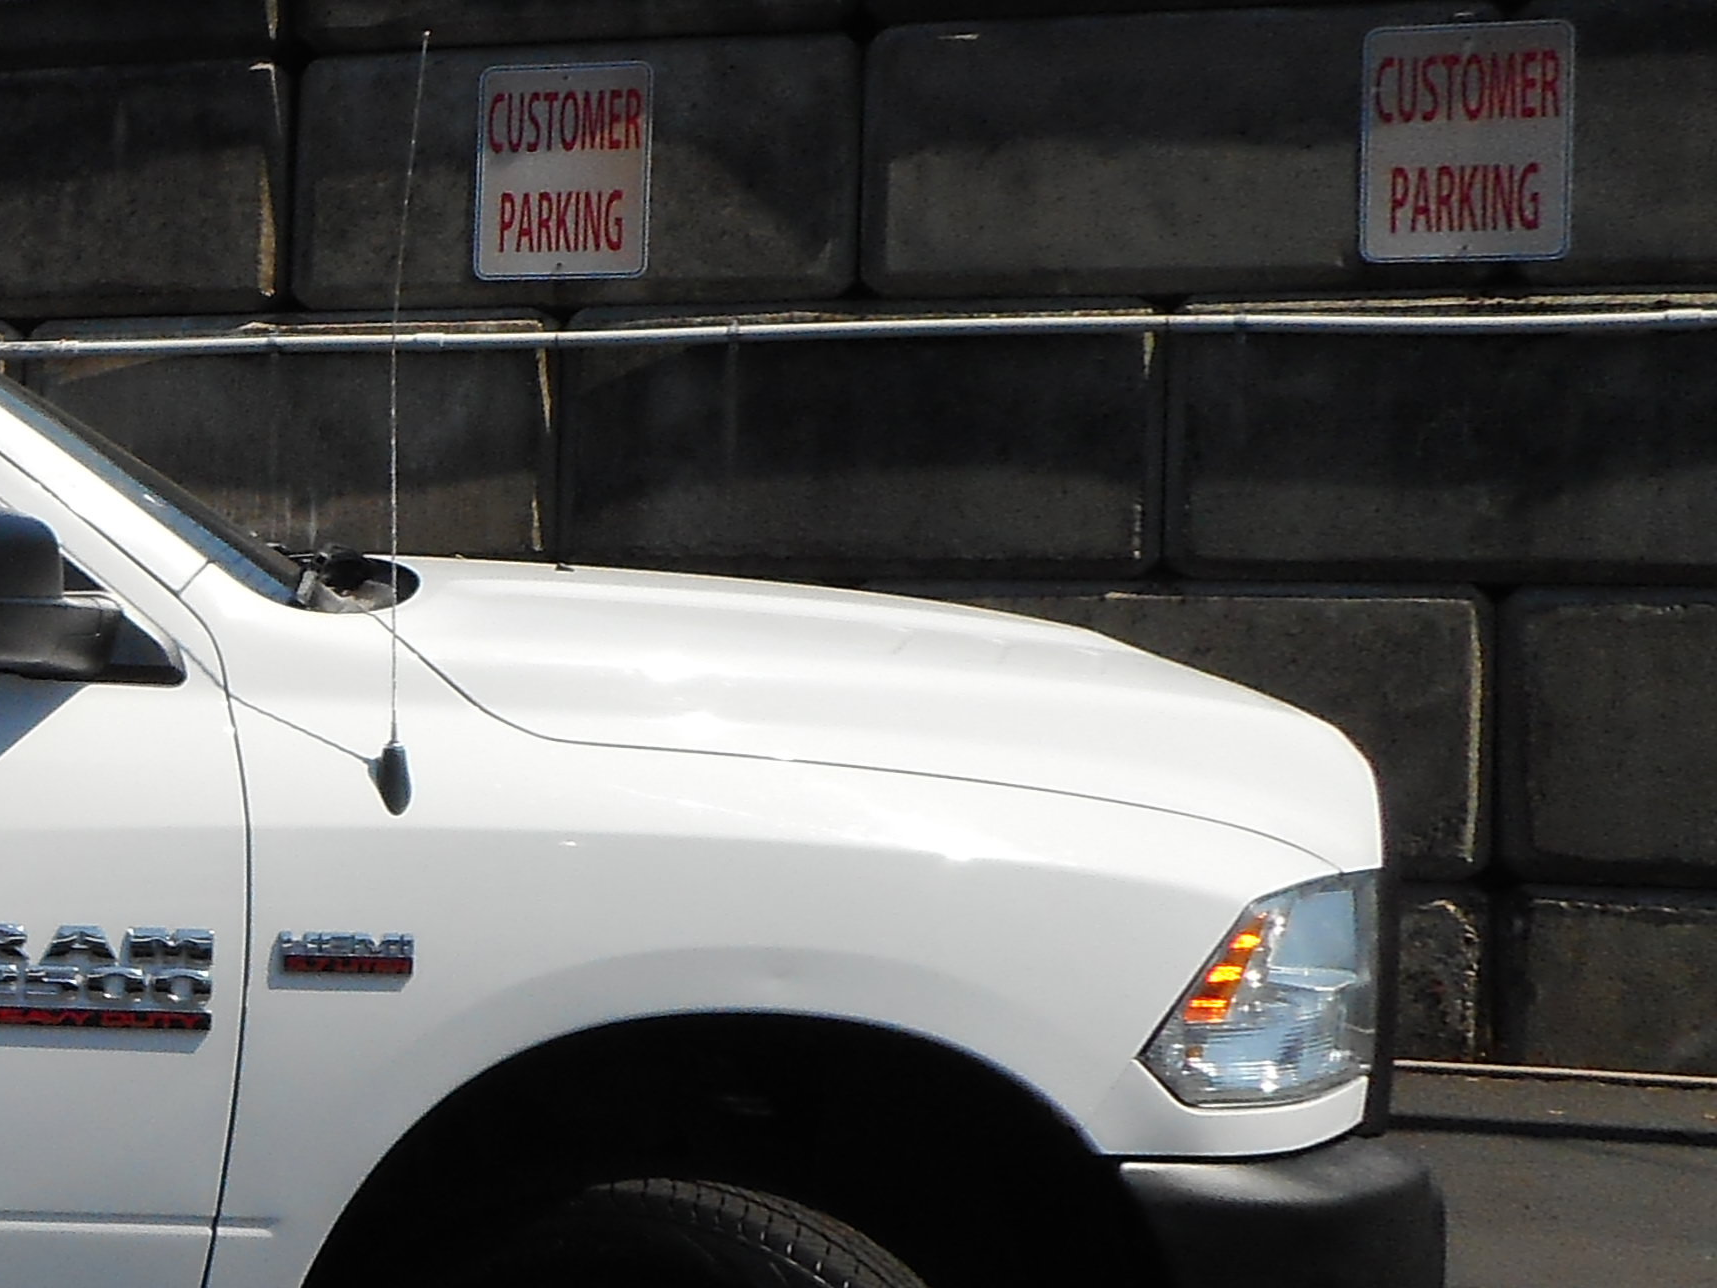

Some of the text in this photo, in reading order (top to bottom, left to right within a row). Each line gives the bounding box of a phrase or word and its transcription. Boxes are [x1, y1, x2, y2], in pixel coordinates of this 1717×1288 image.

[1374, 48, 1561, 124] CUSTOMER
[487, 88, 643, 154] CUSTOMER
[497, 189, 624, 253] PARKING
[1389, 161, 1541, 234] PARKING
[100, 1009, 205, 1031] DUTY
